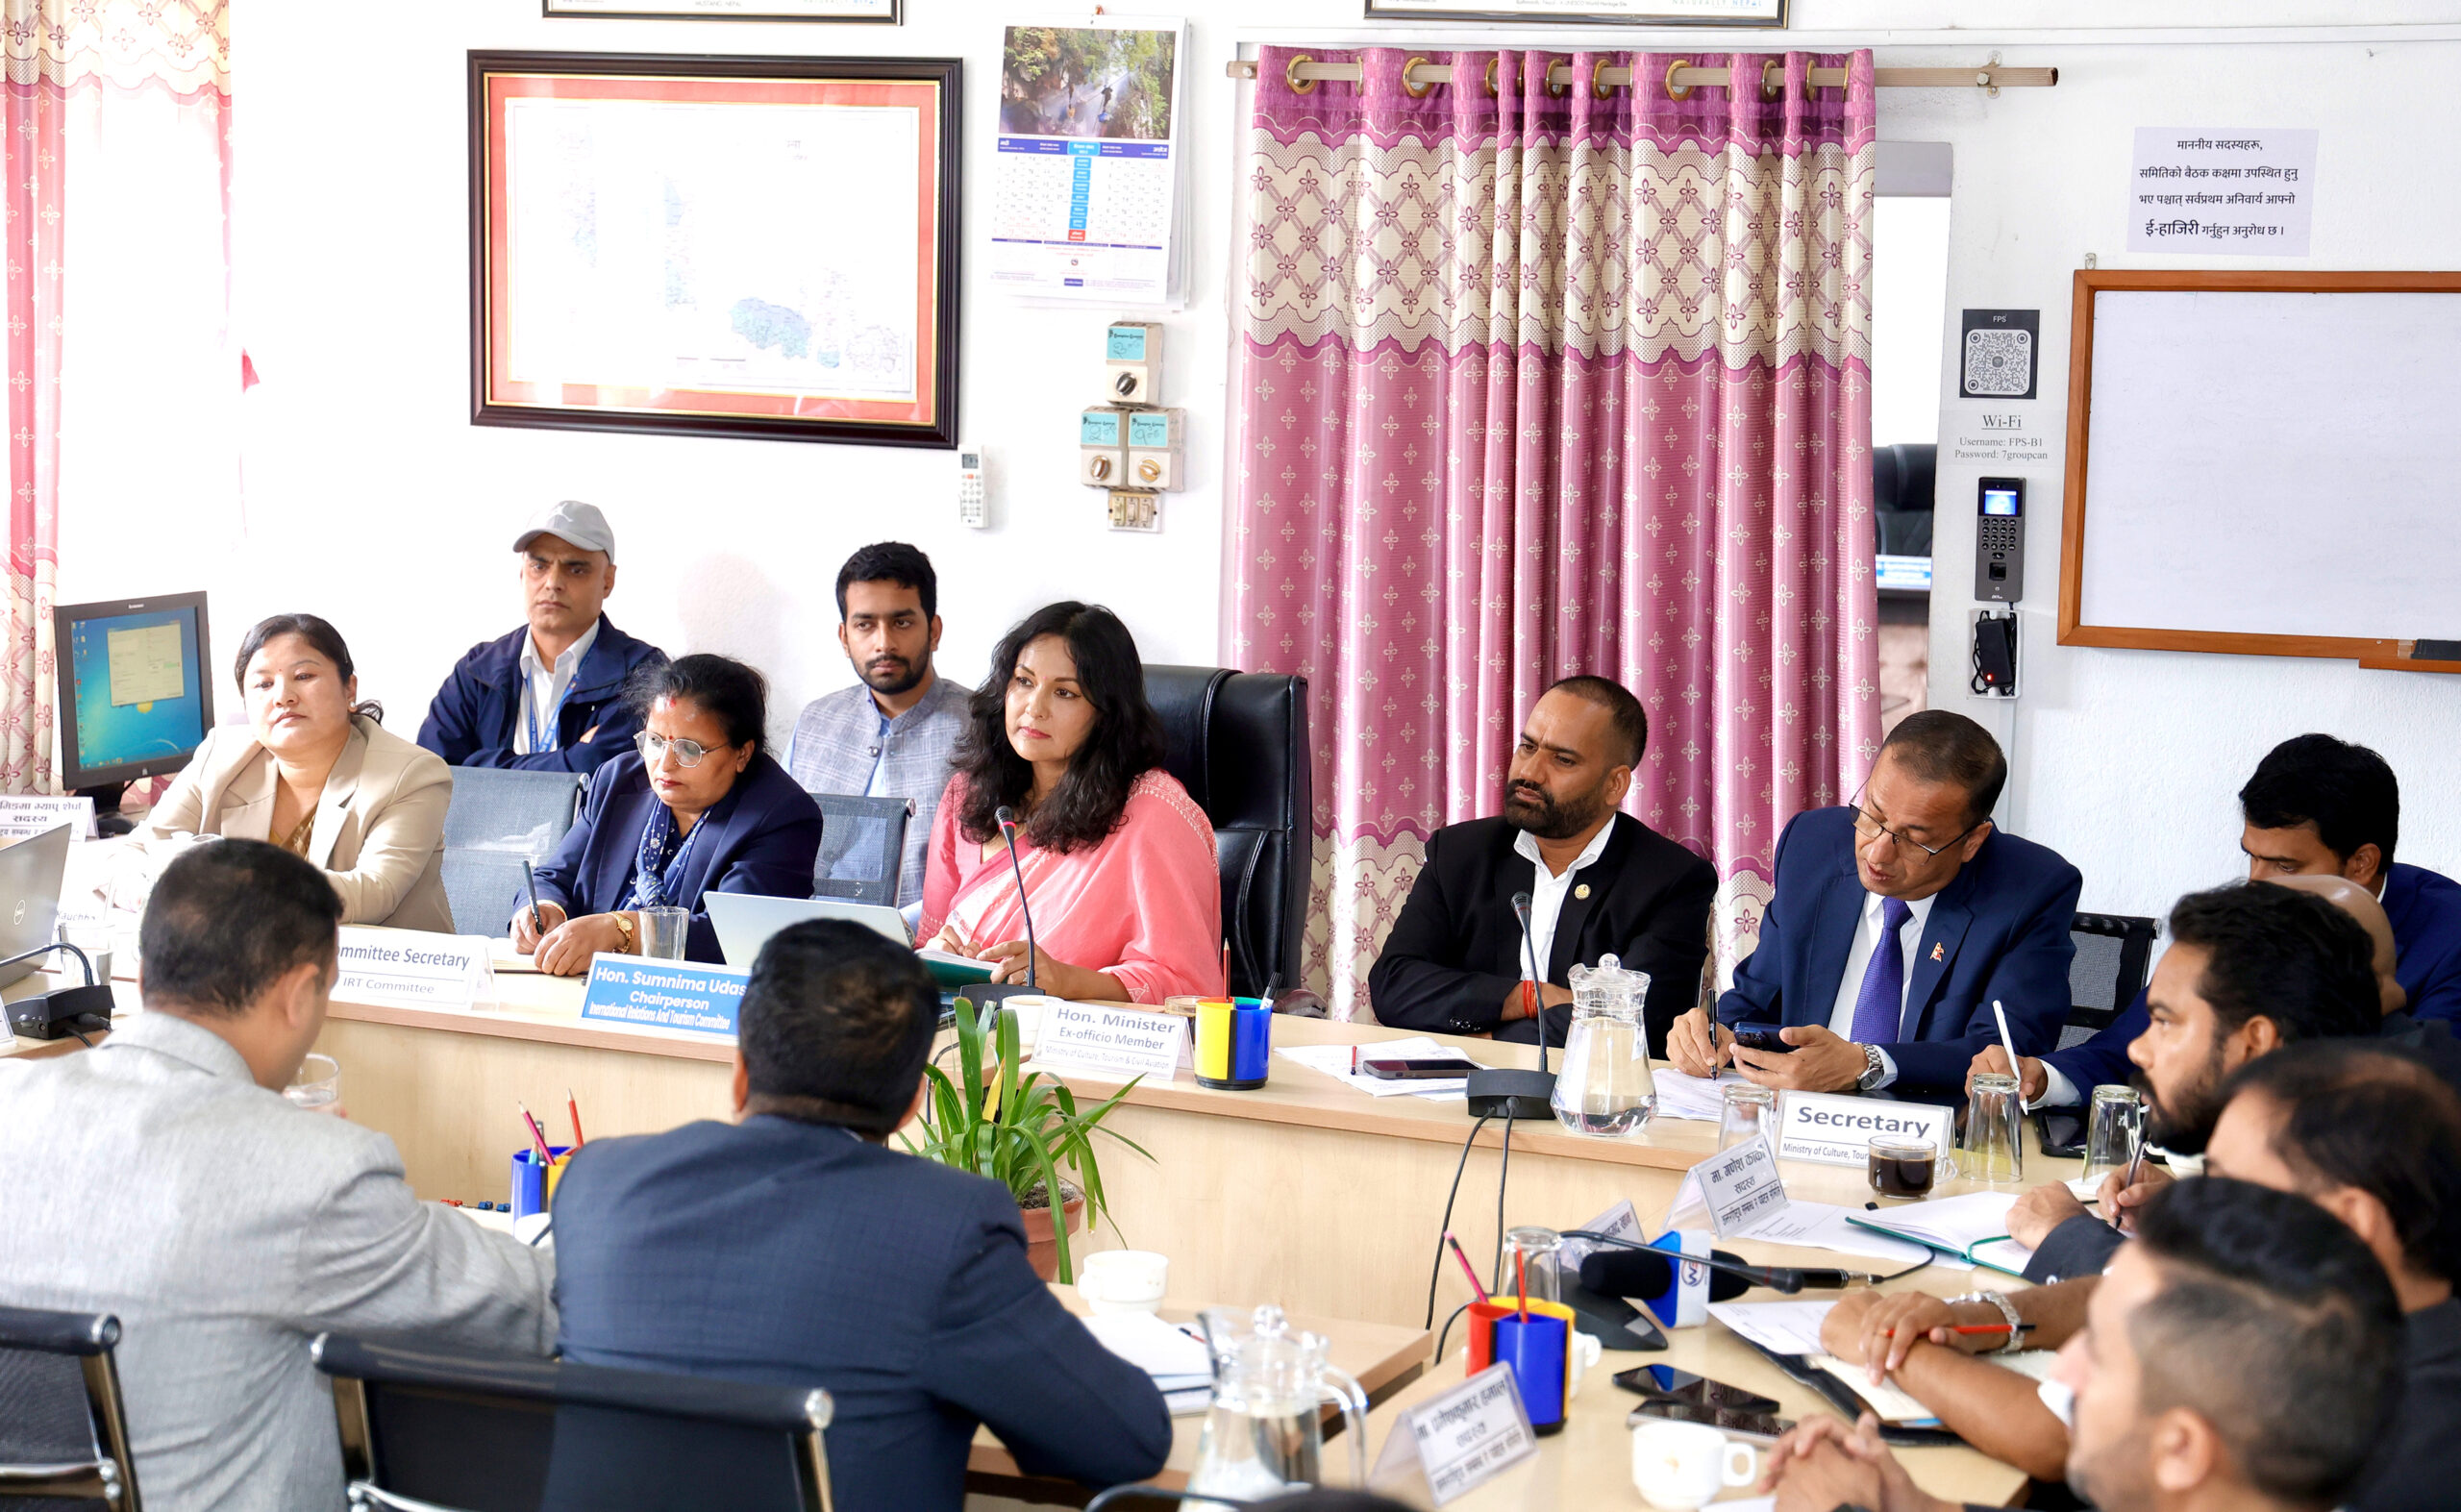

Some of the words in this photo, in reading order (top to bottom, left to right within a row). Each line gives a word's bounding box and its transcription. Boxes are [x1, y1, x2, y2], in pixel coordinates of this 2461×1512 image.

[2177, 138, 2212, 150] माननीय
[2140, 166, 2181, 179] समितिको
[2185, 165, 2209, 178] बैठक
[2212, 168, 2241, 179] कक्षमा
[2245, 166, 2280, 179] उपस्थित
[2284, 168, 2298, 182] हुनु
[2139, 194, 2153, 204] भए
[2185, 192, 2223, 204] सर्वप्रथम
[2226, 192, 2263, 204] अनिवार्य
[2266, 192, 2296, 204] आफ्नो
[2146, 219, 2200, 238] ई-हाजिरी
[2202, 224, 2229, 238] गर्नुहुन
[2233, 224, 2265, 238] अनुरोध
[2269, 226, 2276, 235] छ
[1983, 415, 2022, 427] Wi-Fi
[1960, 437, 2005, 446] Username:
[1955, 450, 1998, 459] Password:
[2001, 450, 2048, 461] 7groupcan
[404, 949, 469, 971] Secretary
[344, 978, 363, 986] IRT
[366, 979, 435, 994] Committee
[596, 967, 629, 984] Hon.
[633, 971, 706, 992] Sumnima
[630, 991, 709, 1010] Chairperson
[629, 1005, 656, 1021] Relations
[656, 1009, 671, 1023] And
[670, 1010, 695, 1026] Tourism
[695, 1013, 731, 1030] Committee
[1057, 1008, 1096, 1023] Hon.
[1103, 1014, 1176, 1033] Minister
[1059, 1027, 1111, 1044] Ex-officio
[1115, 1033, 1164, 1050] Member
[1046, 1046, 1068, 1057] Ministry
[1070, 1047, 1077, 1057] of
[1078, 1049, 1100, 1061] Culture,
[1102, 1053, 1125, 1063] Tourism
[1131, 1056, 1144, 1067] Civil
[1145, 1059, 1169, 1069] Aviation
[1798, 1106, 1930, 1138] Secretary
[1783, 1143, 1811, 1155] Ministry
[1814, 1146, 1822, 1155] of
[1823, 1147, 1851, 1159] Culture,
[1710, 1167, 1724, 1184] मा.
[1724, 1158, 1744, 1177] गणेश
[1734, 1176, 1755, 1194] सदस्य
